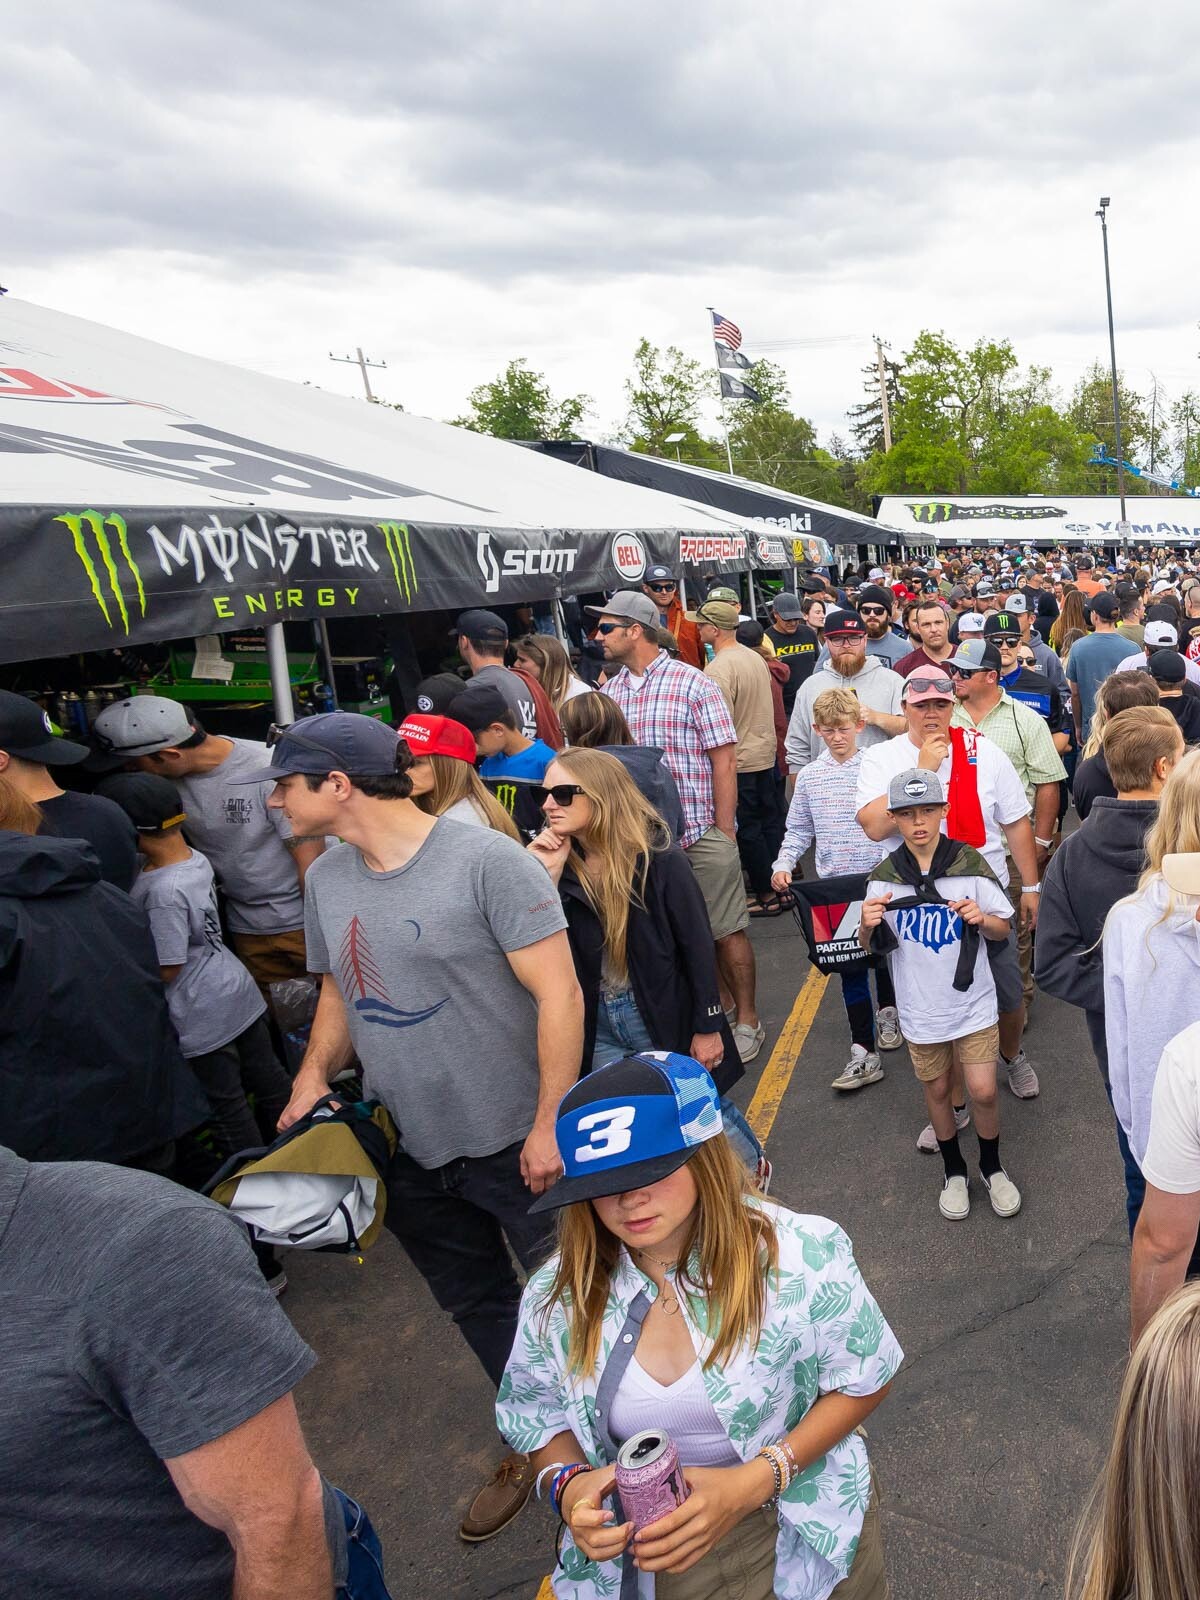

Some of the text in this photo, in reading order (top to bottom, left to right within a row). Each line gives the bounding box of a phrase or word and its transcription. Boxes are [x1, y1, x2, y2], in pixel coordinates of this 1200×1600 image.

[957, 505, 1059, 515] MONSTER
[147, 512, 381, 584] MONSTER
[618, 546, 642, 568] BELL
[502, 549, 578, 576] SCOTT
[213, 587, 359, 618] ENERGY
[900, 908, 959, 944] RMX
[816, 939, 863, 954] PARTZILL
[828, 954, 835, 964] IN
[574, 1105, 637, 1164] 3
